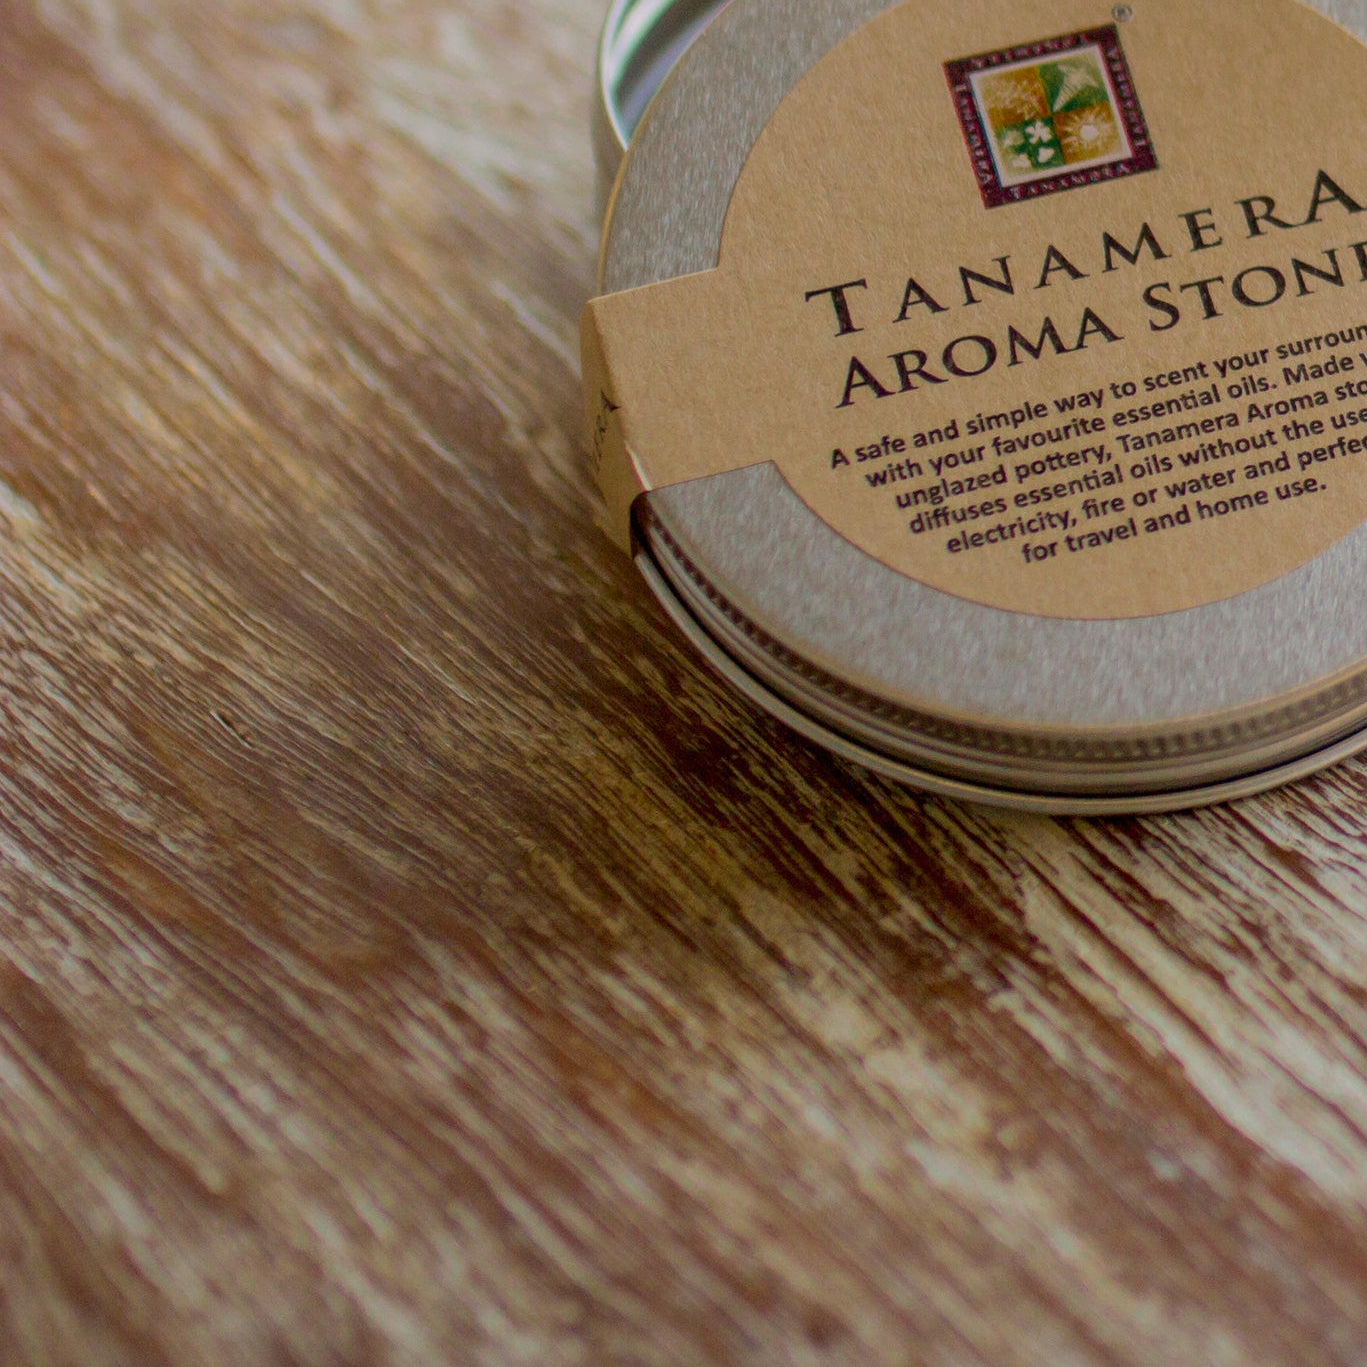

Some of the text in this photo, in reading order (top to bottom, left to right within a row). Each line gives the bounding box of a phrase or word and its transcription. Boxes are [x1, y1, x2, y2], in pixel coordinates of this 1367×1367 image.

[831, 449, 850, 469] A
[855, 436, 906, 463] safe
[913, 419, 960, 448] and
[966, 401, 1048, 435] simple
[1053, 388, 1104, 413] way
[1110, 381, 1137, 399] to
[1145, 362, 1209, 392] scent
[1213, 348, 1269, 378] your
[834, 306, 1124, 409] AROMA
[865, 459, 923, 488] with
[929, 444, 986, 476] your
[992, 416, 1106, 457] favourite
[1112, 384, 1221, 427] essential
[1227, 375, 1277, 400] oils.
[1283, 355, 1354, 386] Made
[896, 465, 1007, 509] unglazed
[1015, 444, 1112, 484] pottery,
[1116, 412, 1239, 454] Tanamera
[1247, 391, 1329, 423] Aroma
[910, 497, 1008, 534] diffuses
[1013, 464, 1123, 508] essential
[1129, 454, 1173, 479] oils
[1178, 431, 1277, 467] without
[1282, 419, 1324, 442] the
[946, 510, 1077, 553] electricity,
[1082, 494, 1125, 519] fire
[1132, 488, 1158, 508] or
[1164, 467, 1236, 499] water
[1244, 452, 1291, 480] and
[1021, 477, 1327, 564] for travel and home use.
